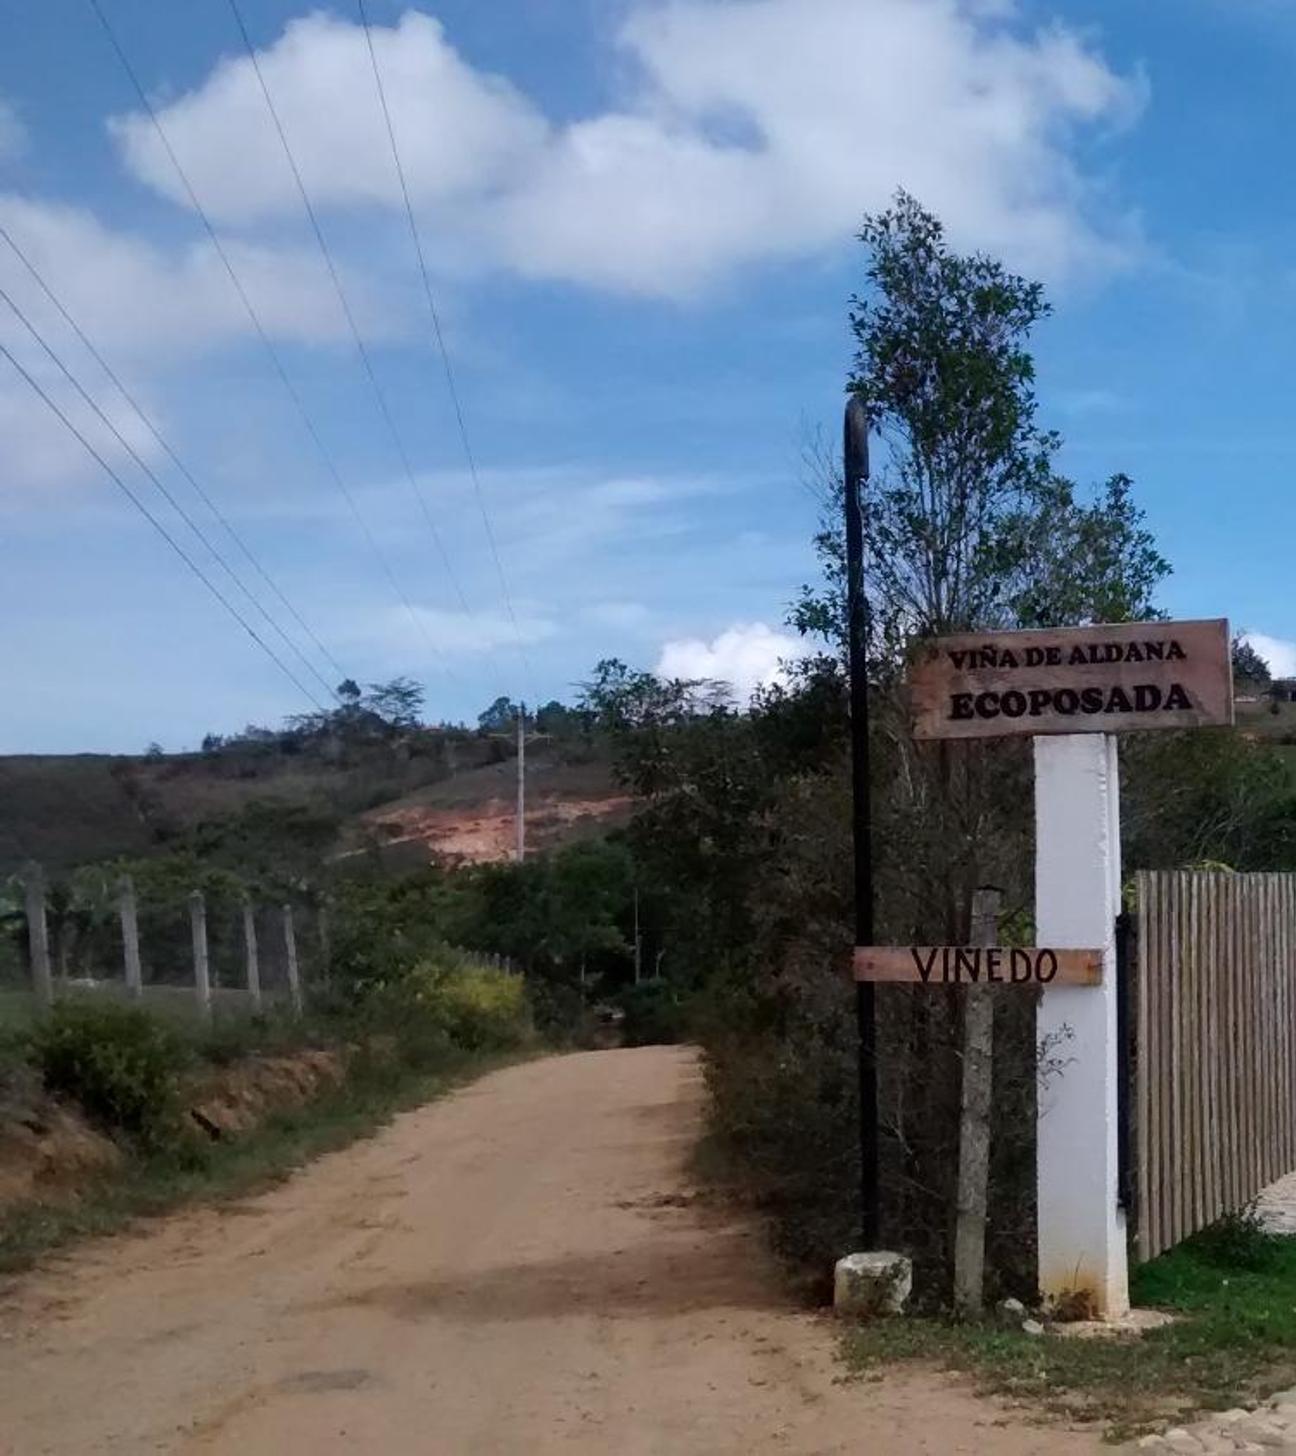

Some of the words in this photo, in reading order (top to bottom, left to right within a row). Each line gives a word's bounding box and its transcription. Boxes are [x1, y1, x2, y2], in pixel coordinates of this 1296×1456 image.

[948, 644, 1018, 670] VIÑA
[1025, 647, 1061, 667] DE
[1068, 640, 1186, 666] ALDANA
[949, 683, 1193, 720] ECOPOSADA
[911, 947, 1058, 983] VIÑEDO
